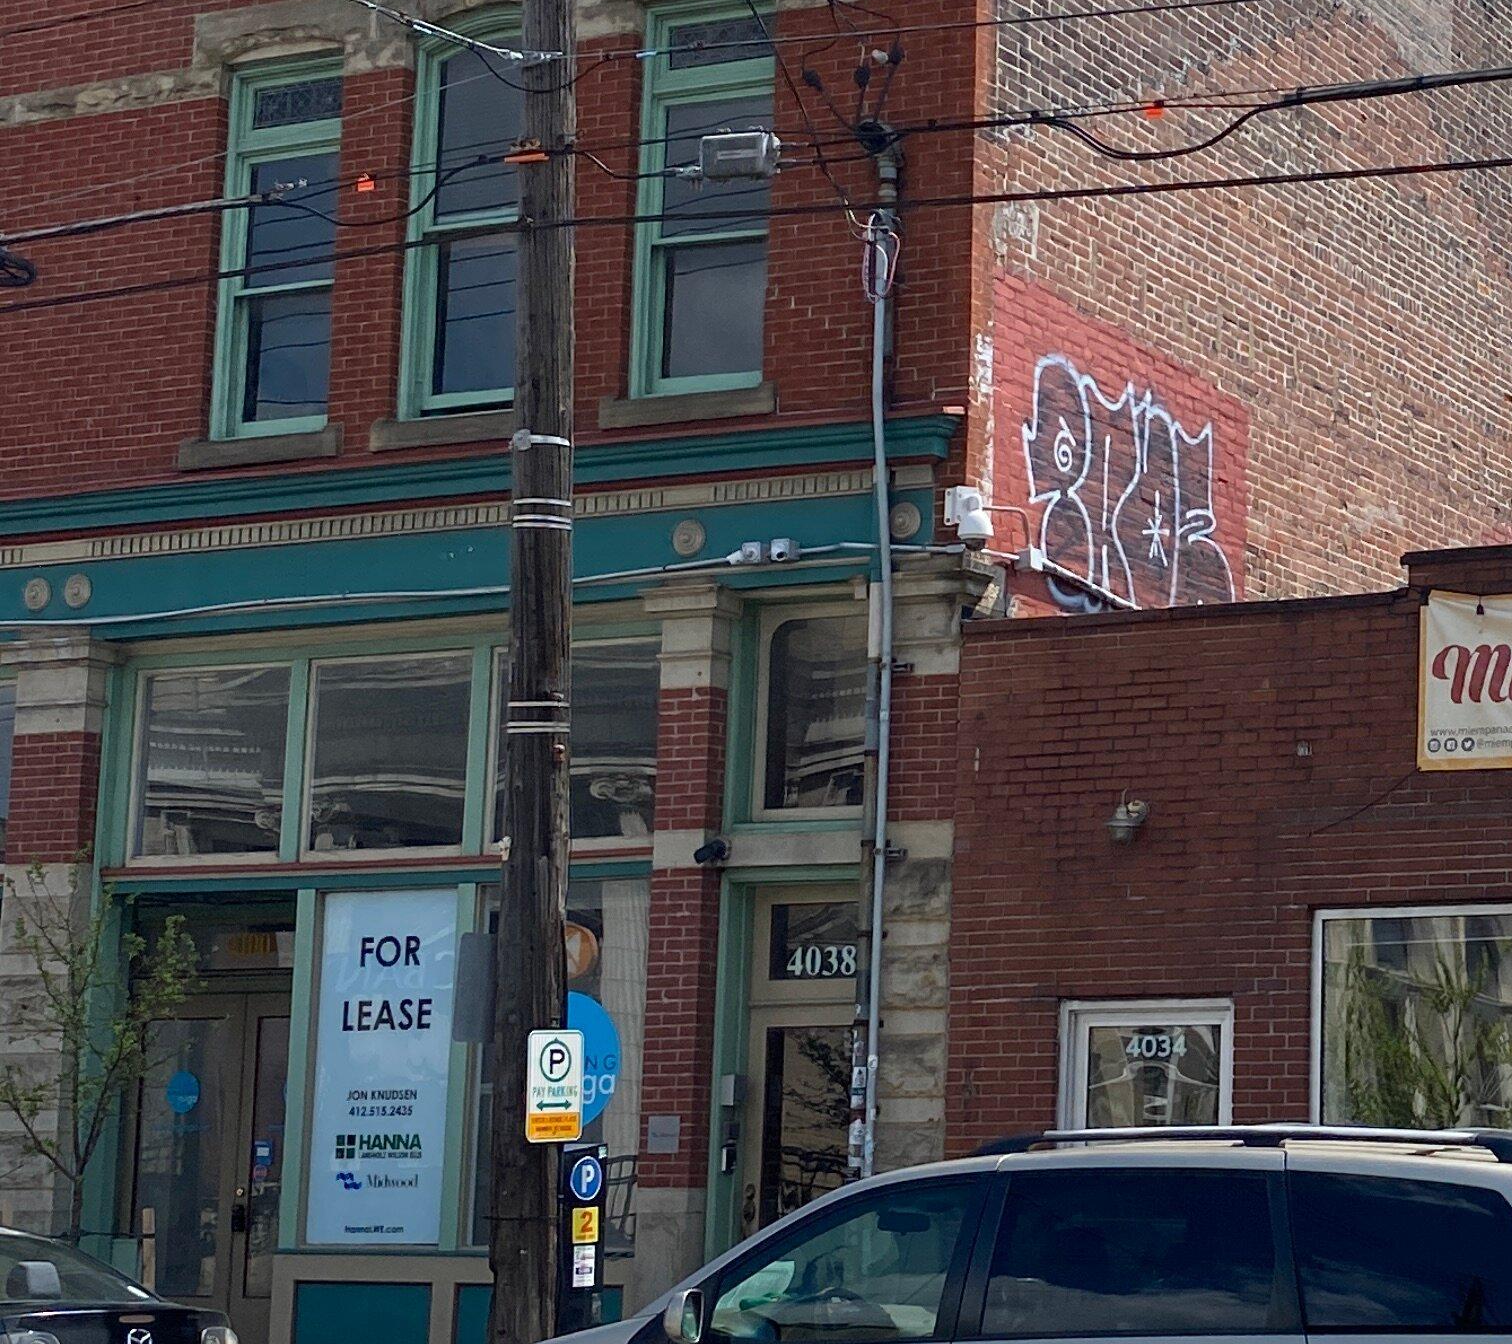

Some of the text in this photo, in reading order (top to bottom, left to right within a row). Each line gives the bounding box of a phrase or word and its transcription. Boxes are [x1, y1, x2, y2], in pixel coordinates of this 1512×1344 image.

[359, 935, 421, 967] FOR
[786, 945, 858, 977] 4038
[341, 998, 433, 1032] LEASE
[1125, 1034, 1188, 1058] 4034
[549, 1048, 566, 1074] P
[346, 1089, 418, 1102] JON KNUDSEN
[532, 1085, 579, 1098] PAY PARKING
[348, 1105, 413, 1117] 412.515.2435
[358, 1134, 422, 1150] HANNA
[367, 1173, 419, 1189] Midwood
[581, 1164, 595, 1194] P
[580, 1211, 593, 1233] 2
